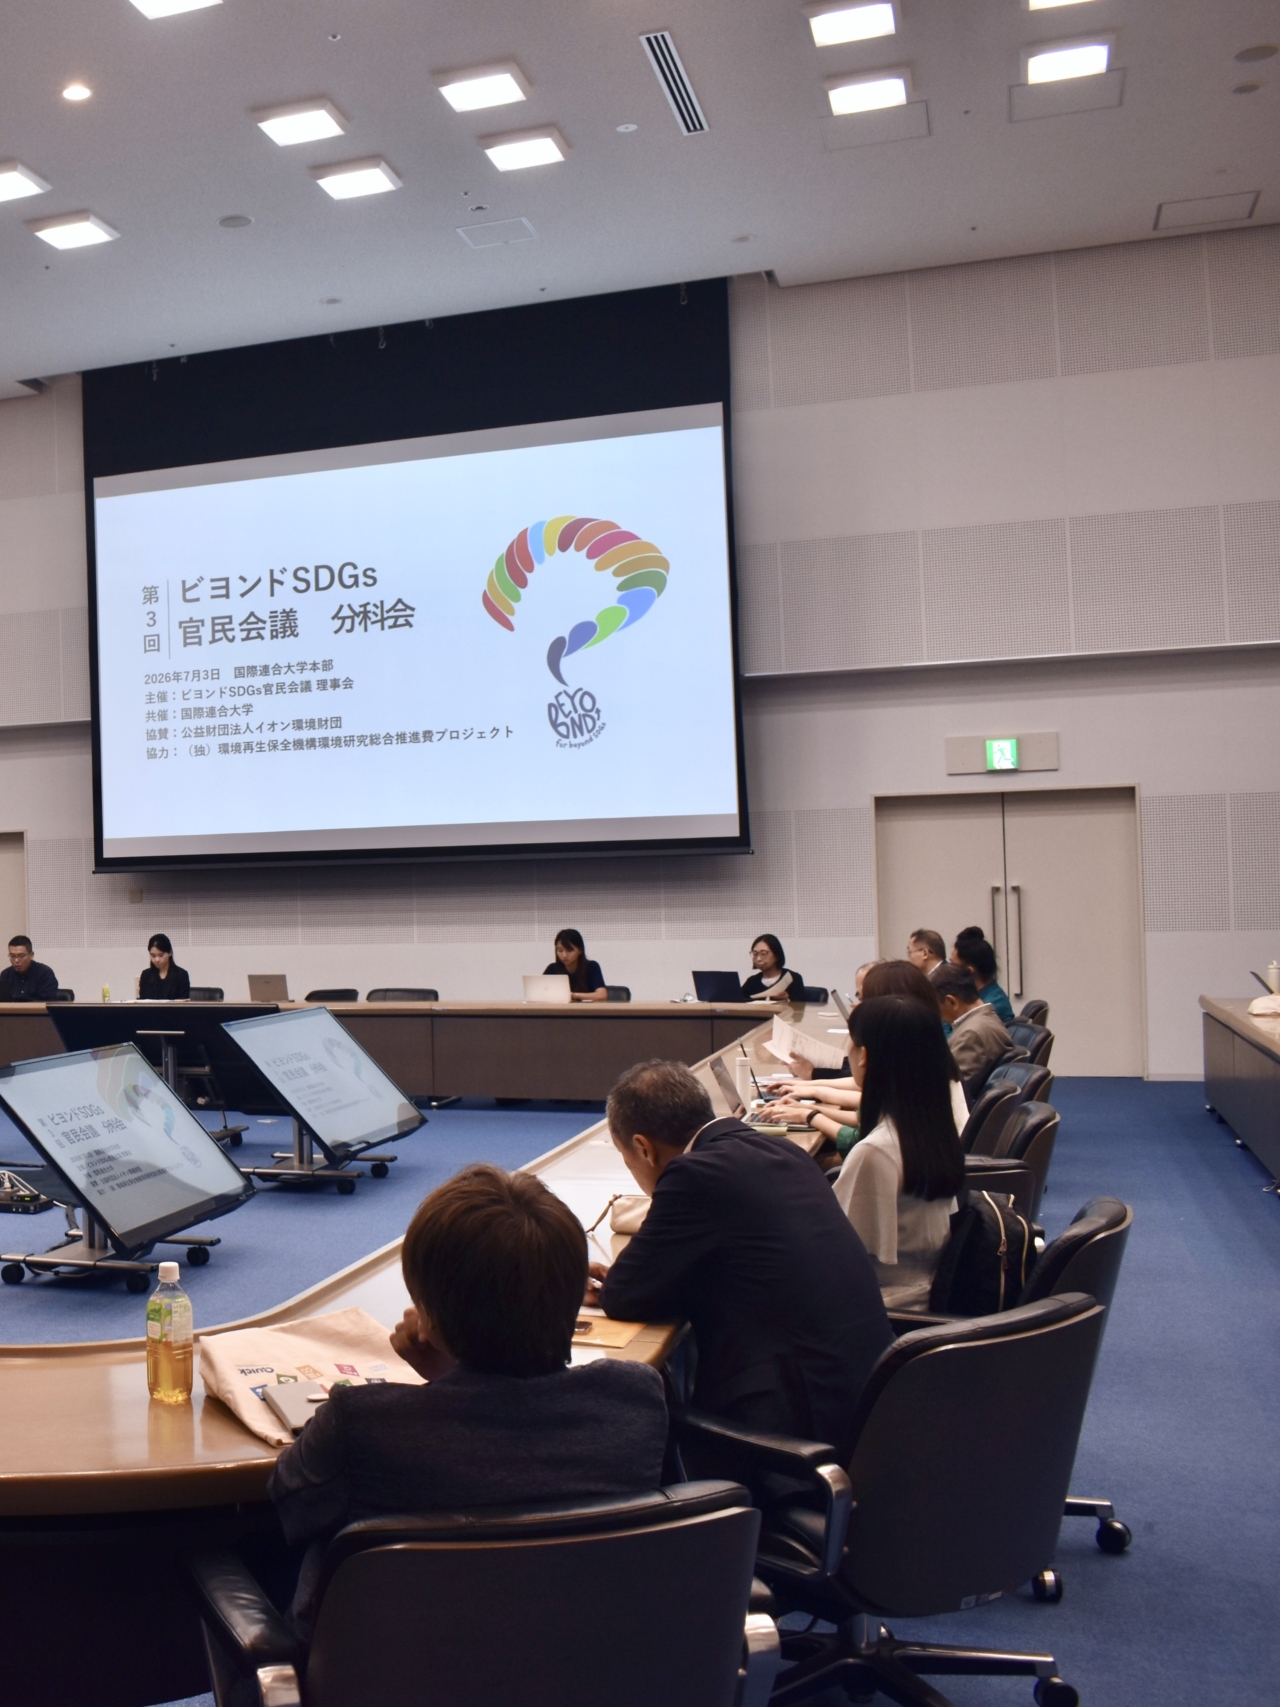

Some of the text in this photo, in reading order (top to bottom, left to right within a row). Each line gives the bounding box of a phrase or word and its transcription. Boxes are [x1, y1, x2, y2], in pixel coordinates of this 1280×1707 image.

[181, 561, 378, 604] ビヨンドSDGs
[178, 597, 417, 648] 官民会議 分科会
[144, 658, 334, 685] 2026年7月3日 国際連合大学本部
[315, 676, 355, 692] 理事会
